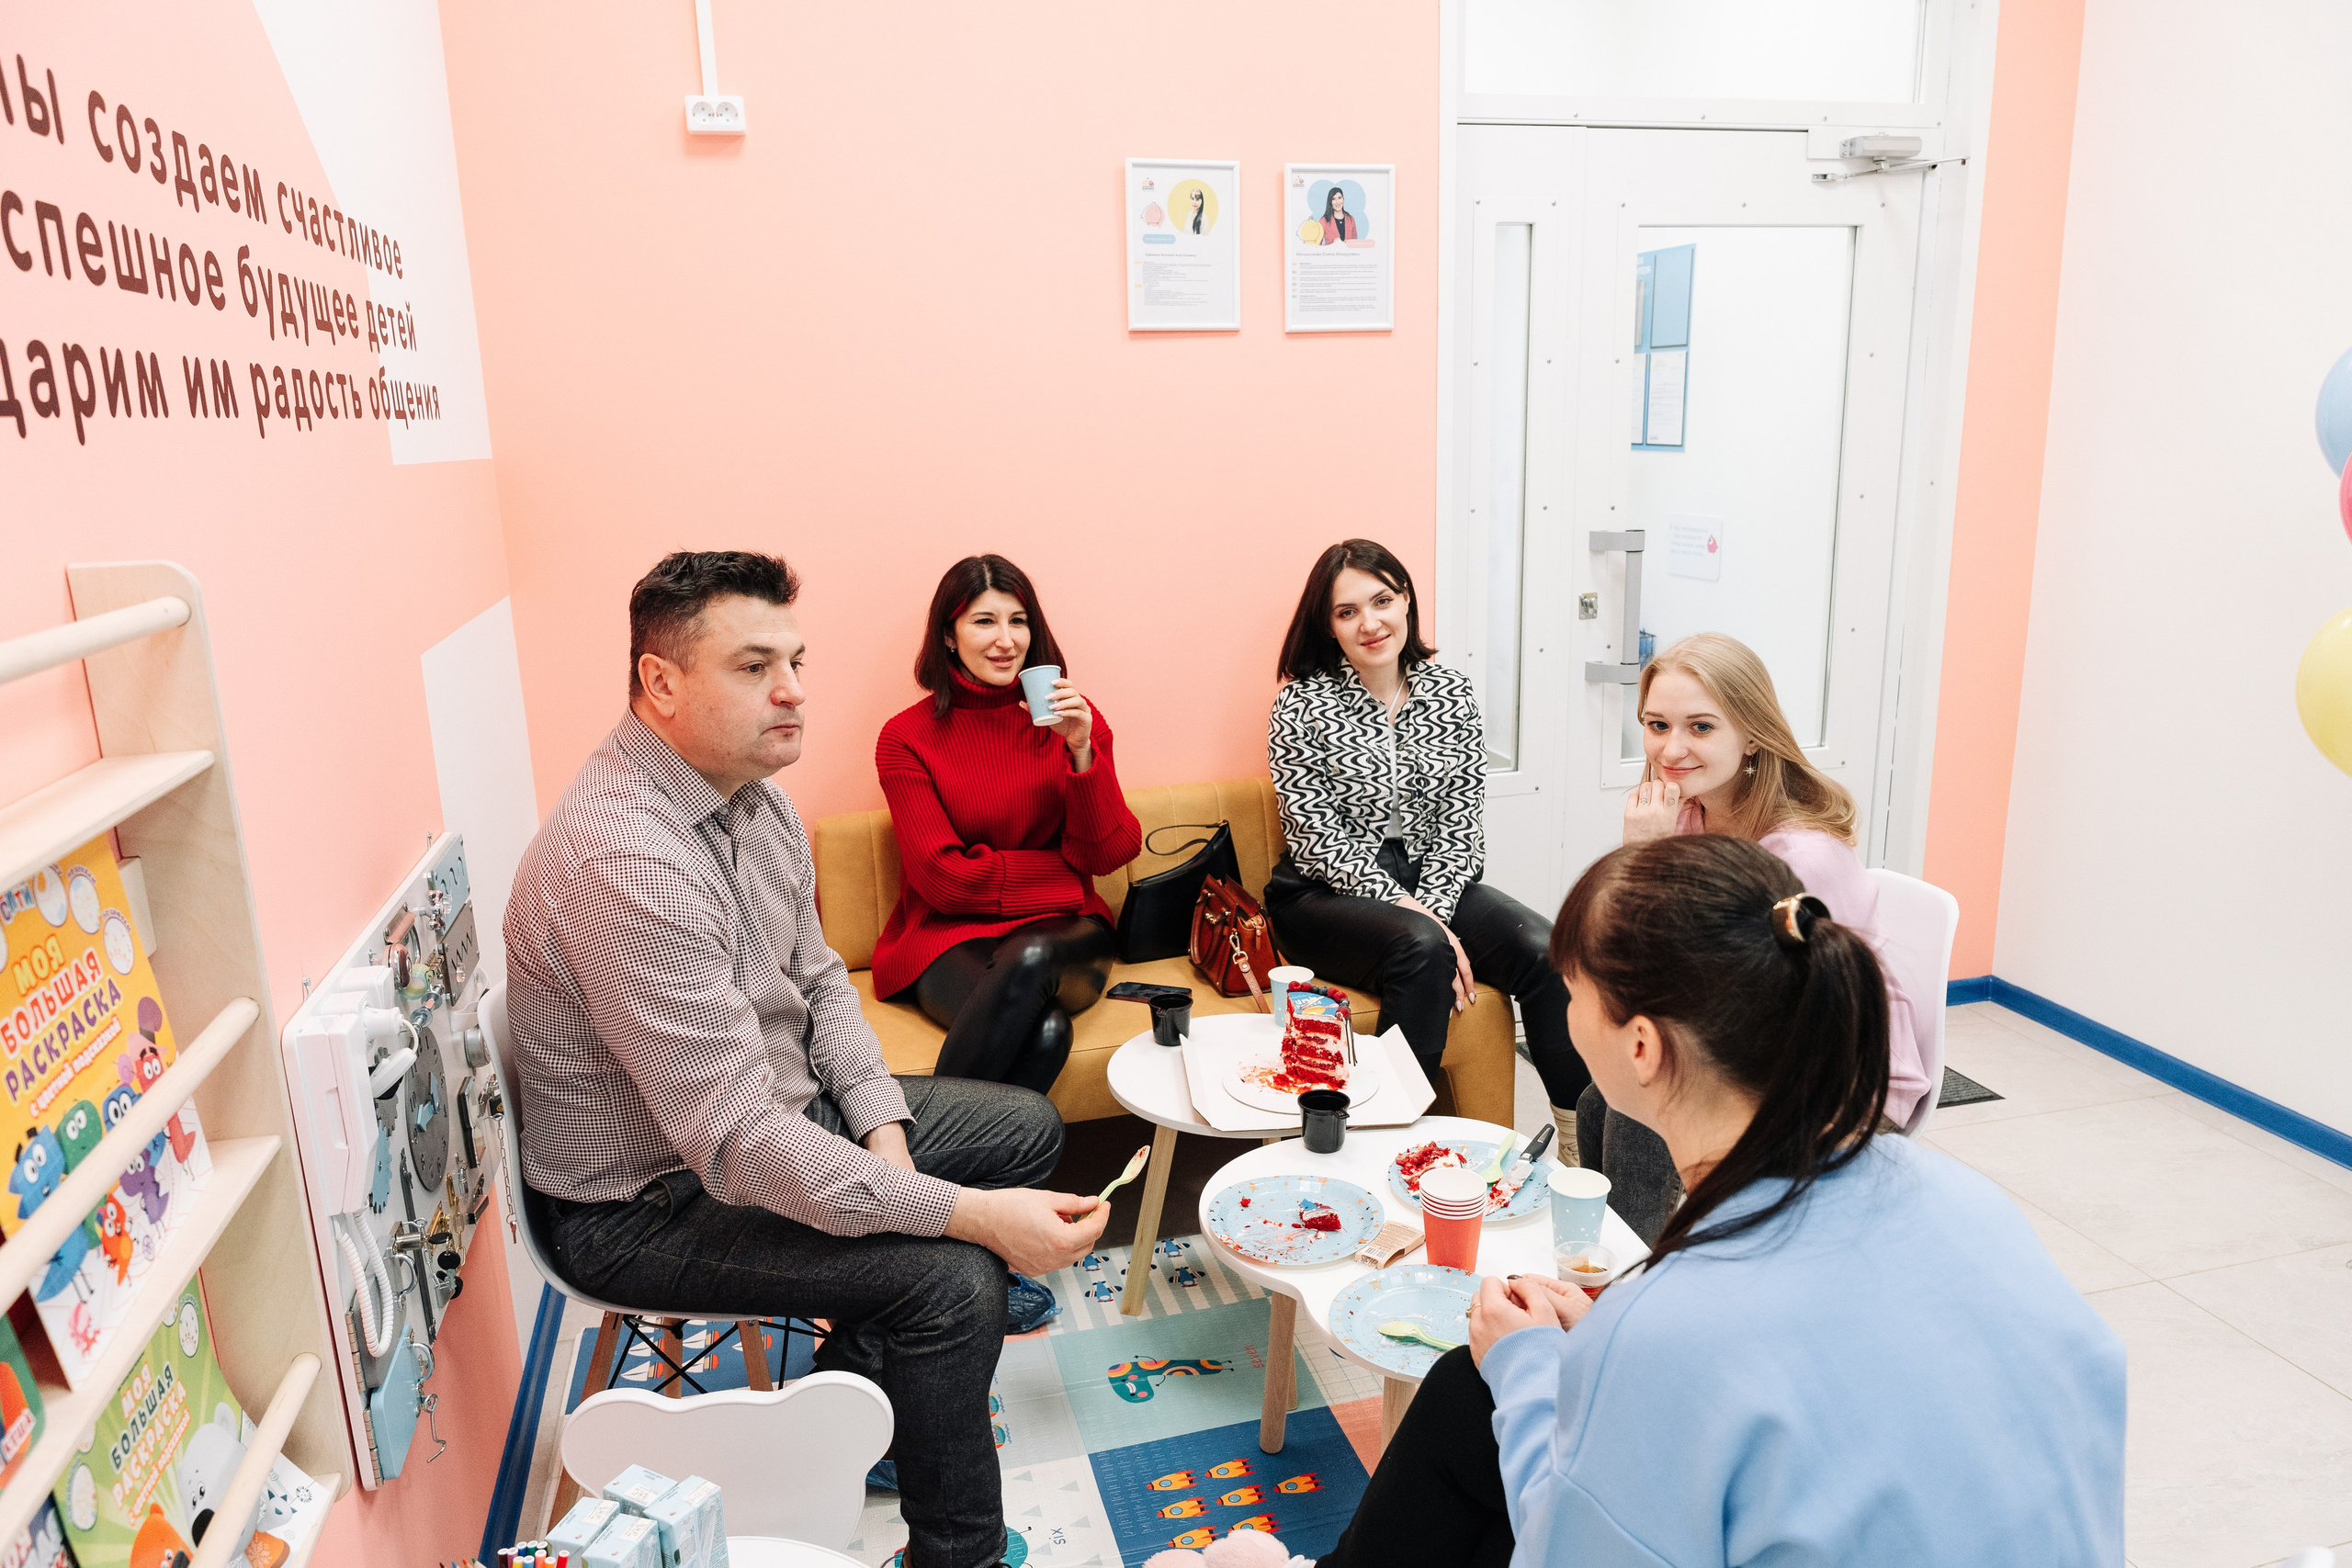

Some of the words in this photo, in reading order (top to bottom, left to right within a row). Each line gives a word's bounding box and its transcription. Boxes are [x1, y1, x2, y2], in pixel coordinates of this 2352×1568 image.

[87, 89, 267, 225] создаем
[277, 181, 403, 280] счастливое
[0, 189, 226, 311] спешное
[236, 243, 359, 347] будущее
[365, 299, 417, 355] детей
[182, 355, 240, 419] им
[249, 362, 363, 440] радость
[368, 366, 441, 430] общения
[0, 949, 102, 1055] БОЛЬШАЯ
[12, 933, 65, 998] МОЯ
[5, 977, 121, 1102] РАСКРАСКА
[121, 1360, 153, 1421] МОЯ
[1245, 1344, 1265, 1369] seven
[110, 1363, 174, 1471] БОЛЬШАЯ
[112, 1378, 187, 1511] РАСКРАСКА
[1048, 1527, 1067, 1545] six
